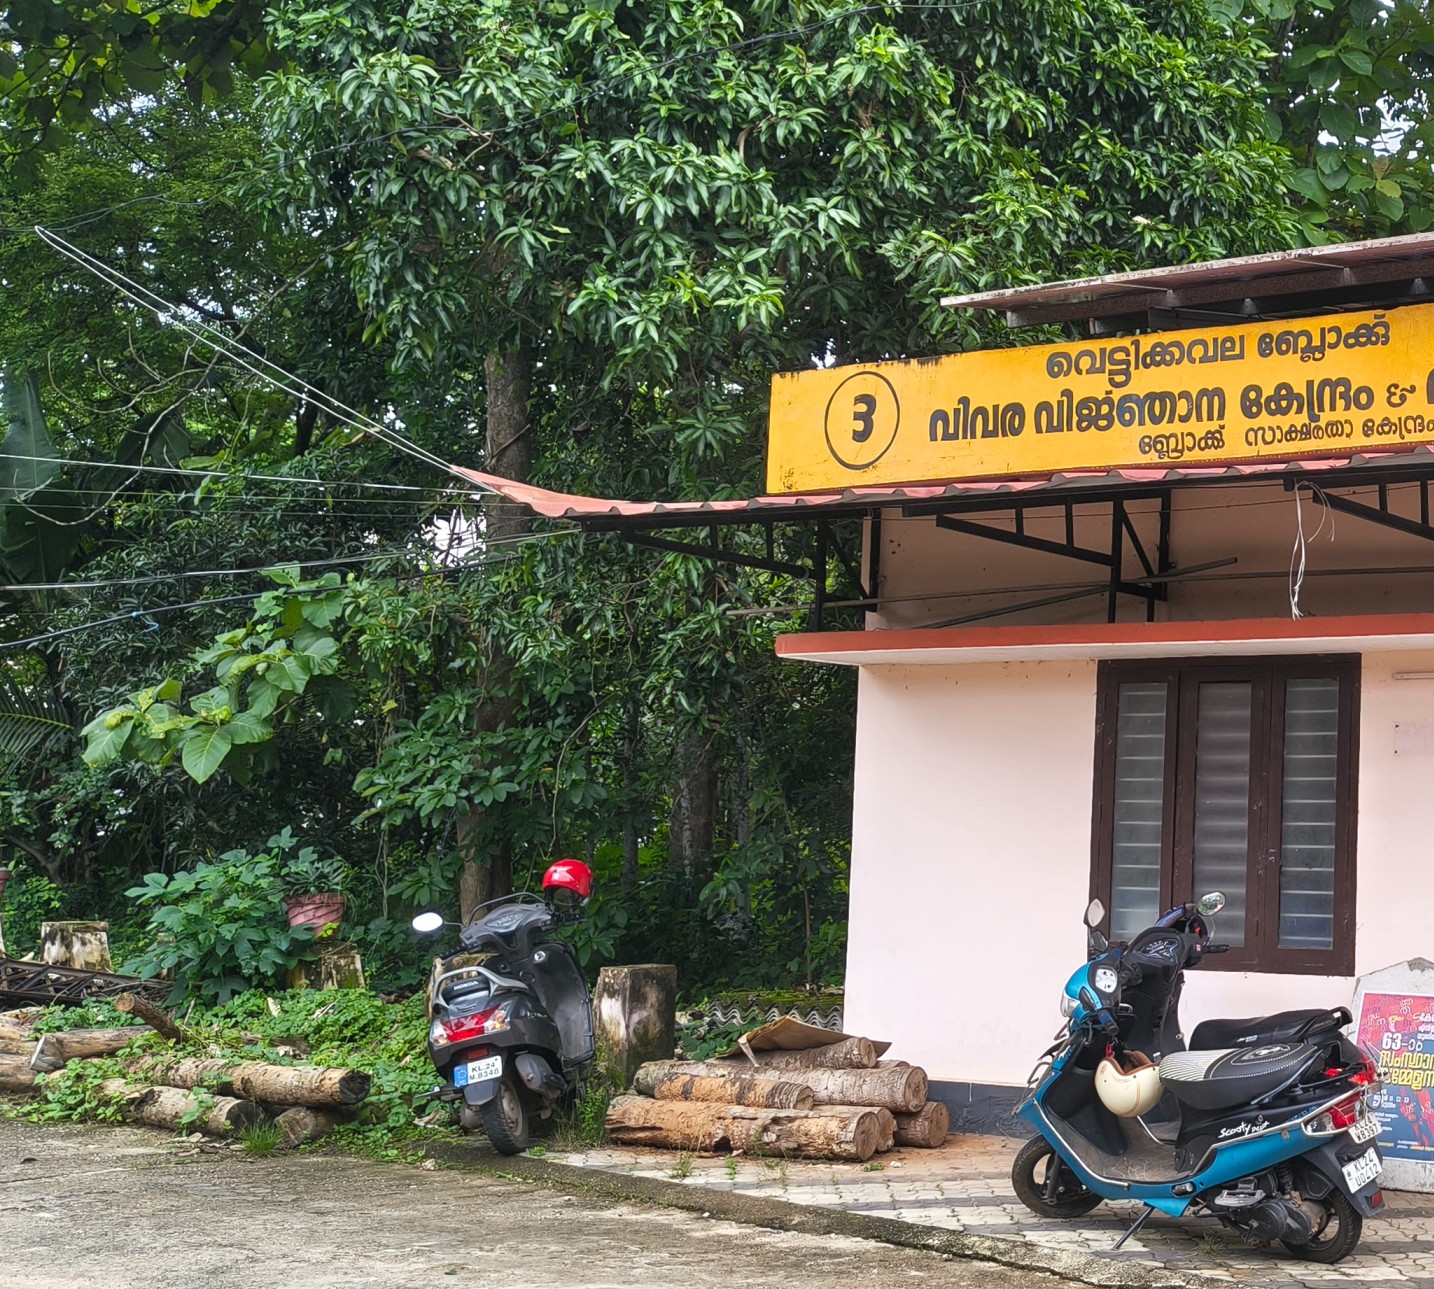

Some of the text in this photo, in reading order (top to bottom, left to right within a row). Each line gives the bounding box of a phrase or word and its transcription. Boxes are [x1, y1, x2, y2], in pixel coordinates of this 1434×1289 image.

[1046, 334, 1246, 389] വെട്ടിക്കവല
[852, 393, 876, 443] 3
[929, 395, 1026, 442] വിവര
[1240, 376, 1375, 423] കേന്ദ്രം
[1386, 382, 1417, 408] &
[1244, 419, 1353, 447] സാക്ഷരതാ
[1218, 1121, 1251, 1138] Scooty
